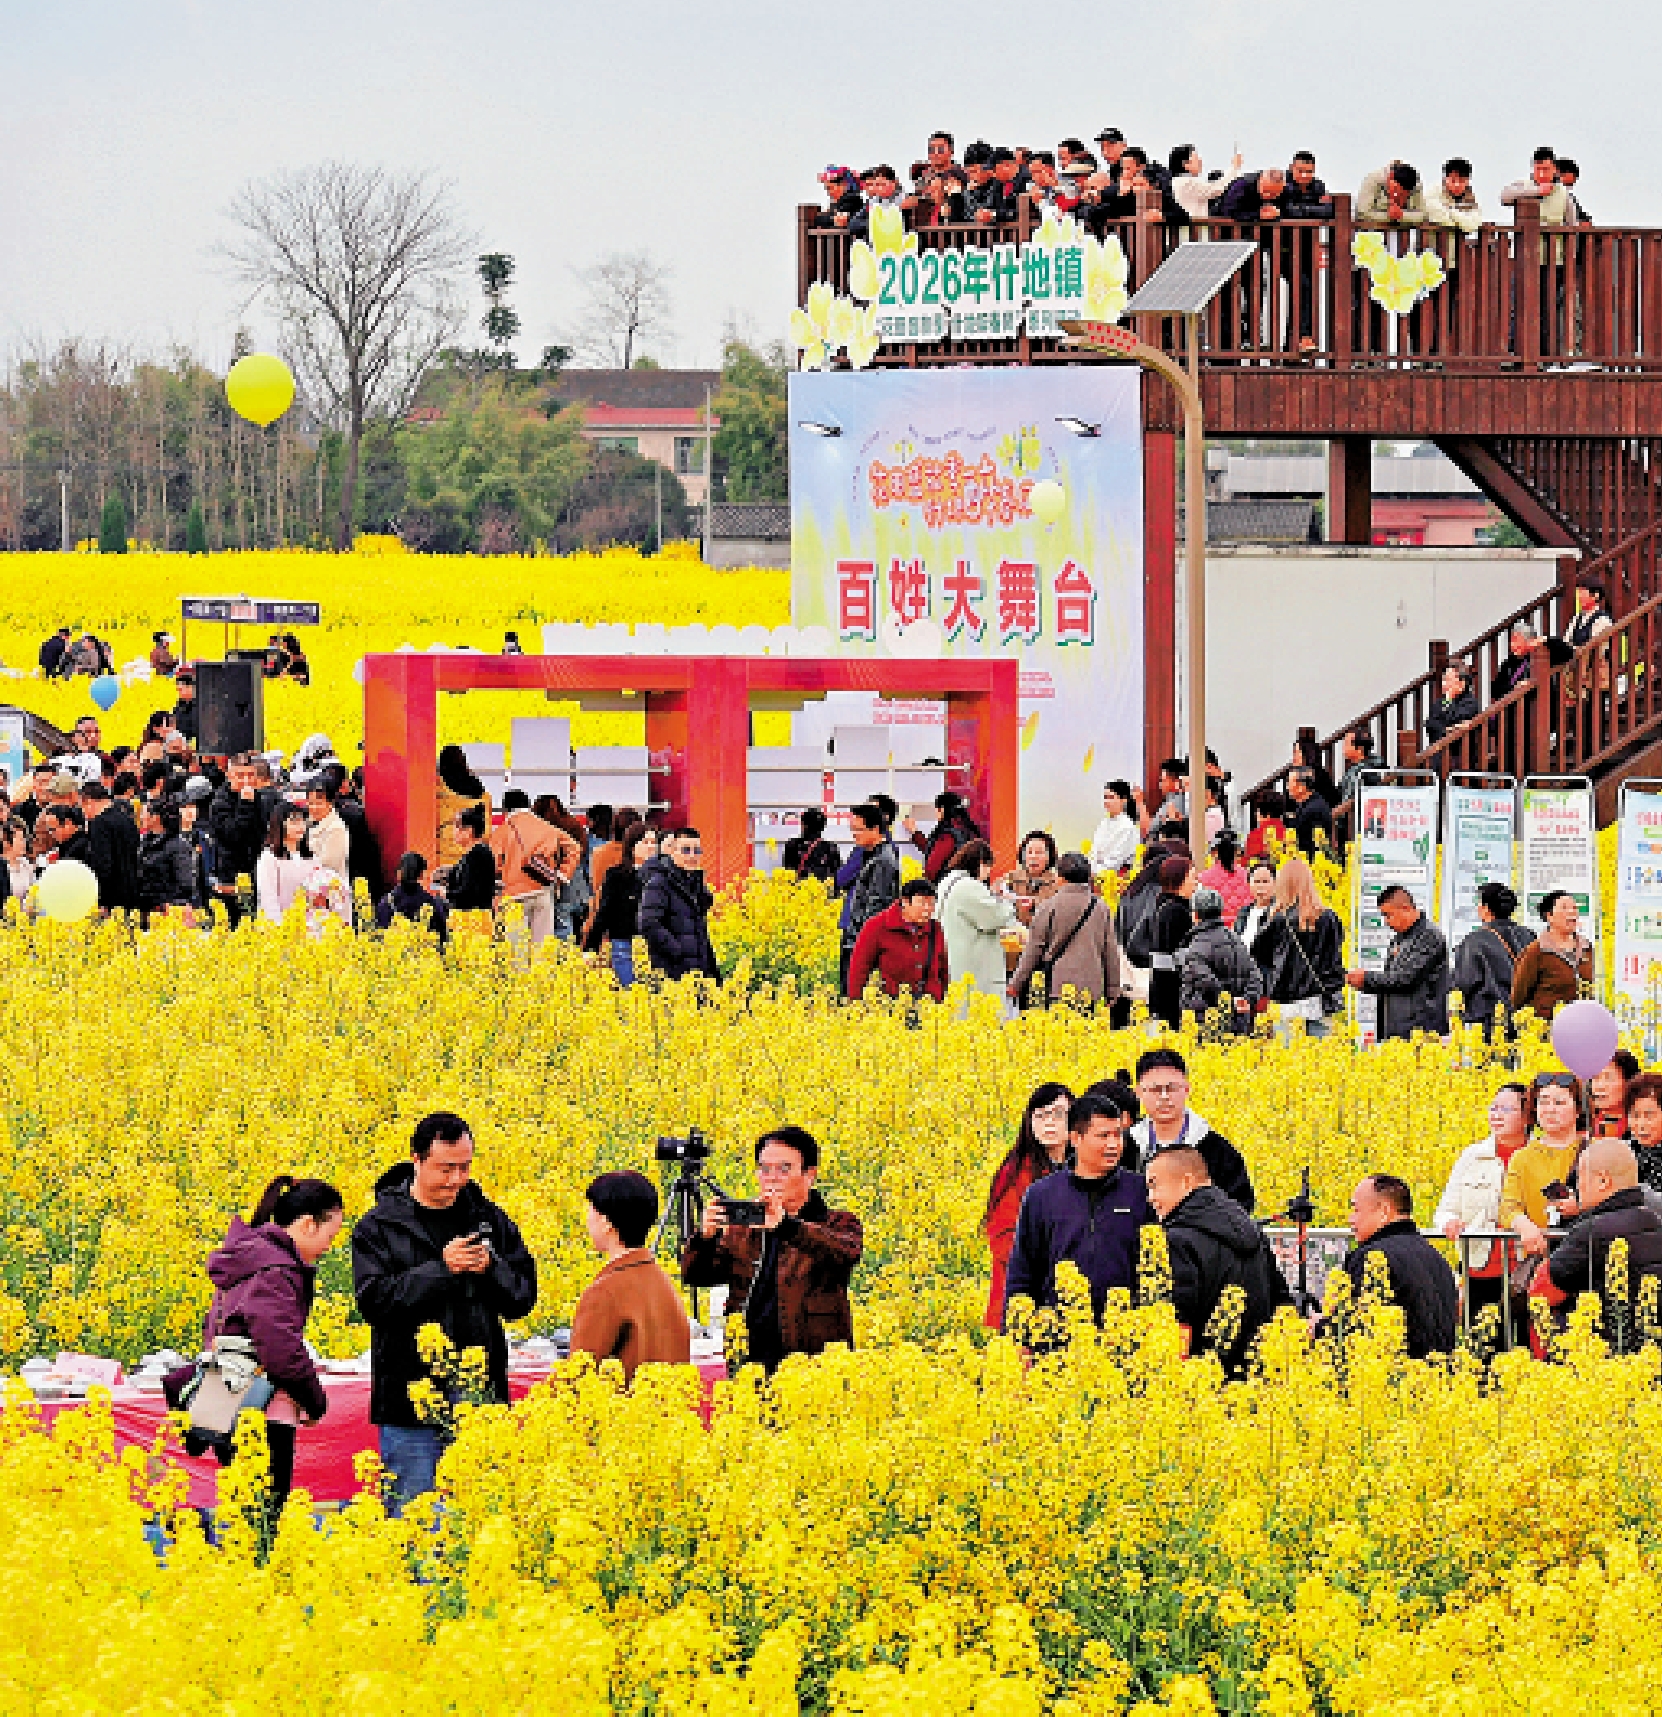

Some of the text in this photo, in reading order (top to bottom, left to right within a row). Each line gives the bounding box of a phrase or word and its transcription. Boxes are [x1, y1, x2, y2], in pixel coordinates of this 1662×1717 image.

[879, 247, 1084, 304] 2026年什地镇
[836, 557, 1098, 645] 百姓大舞台
